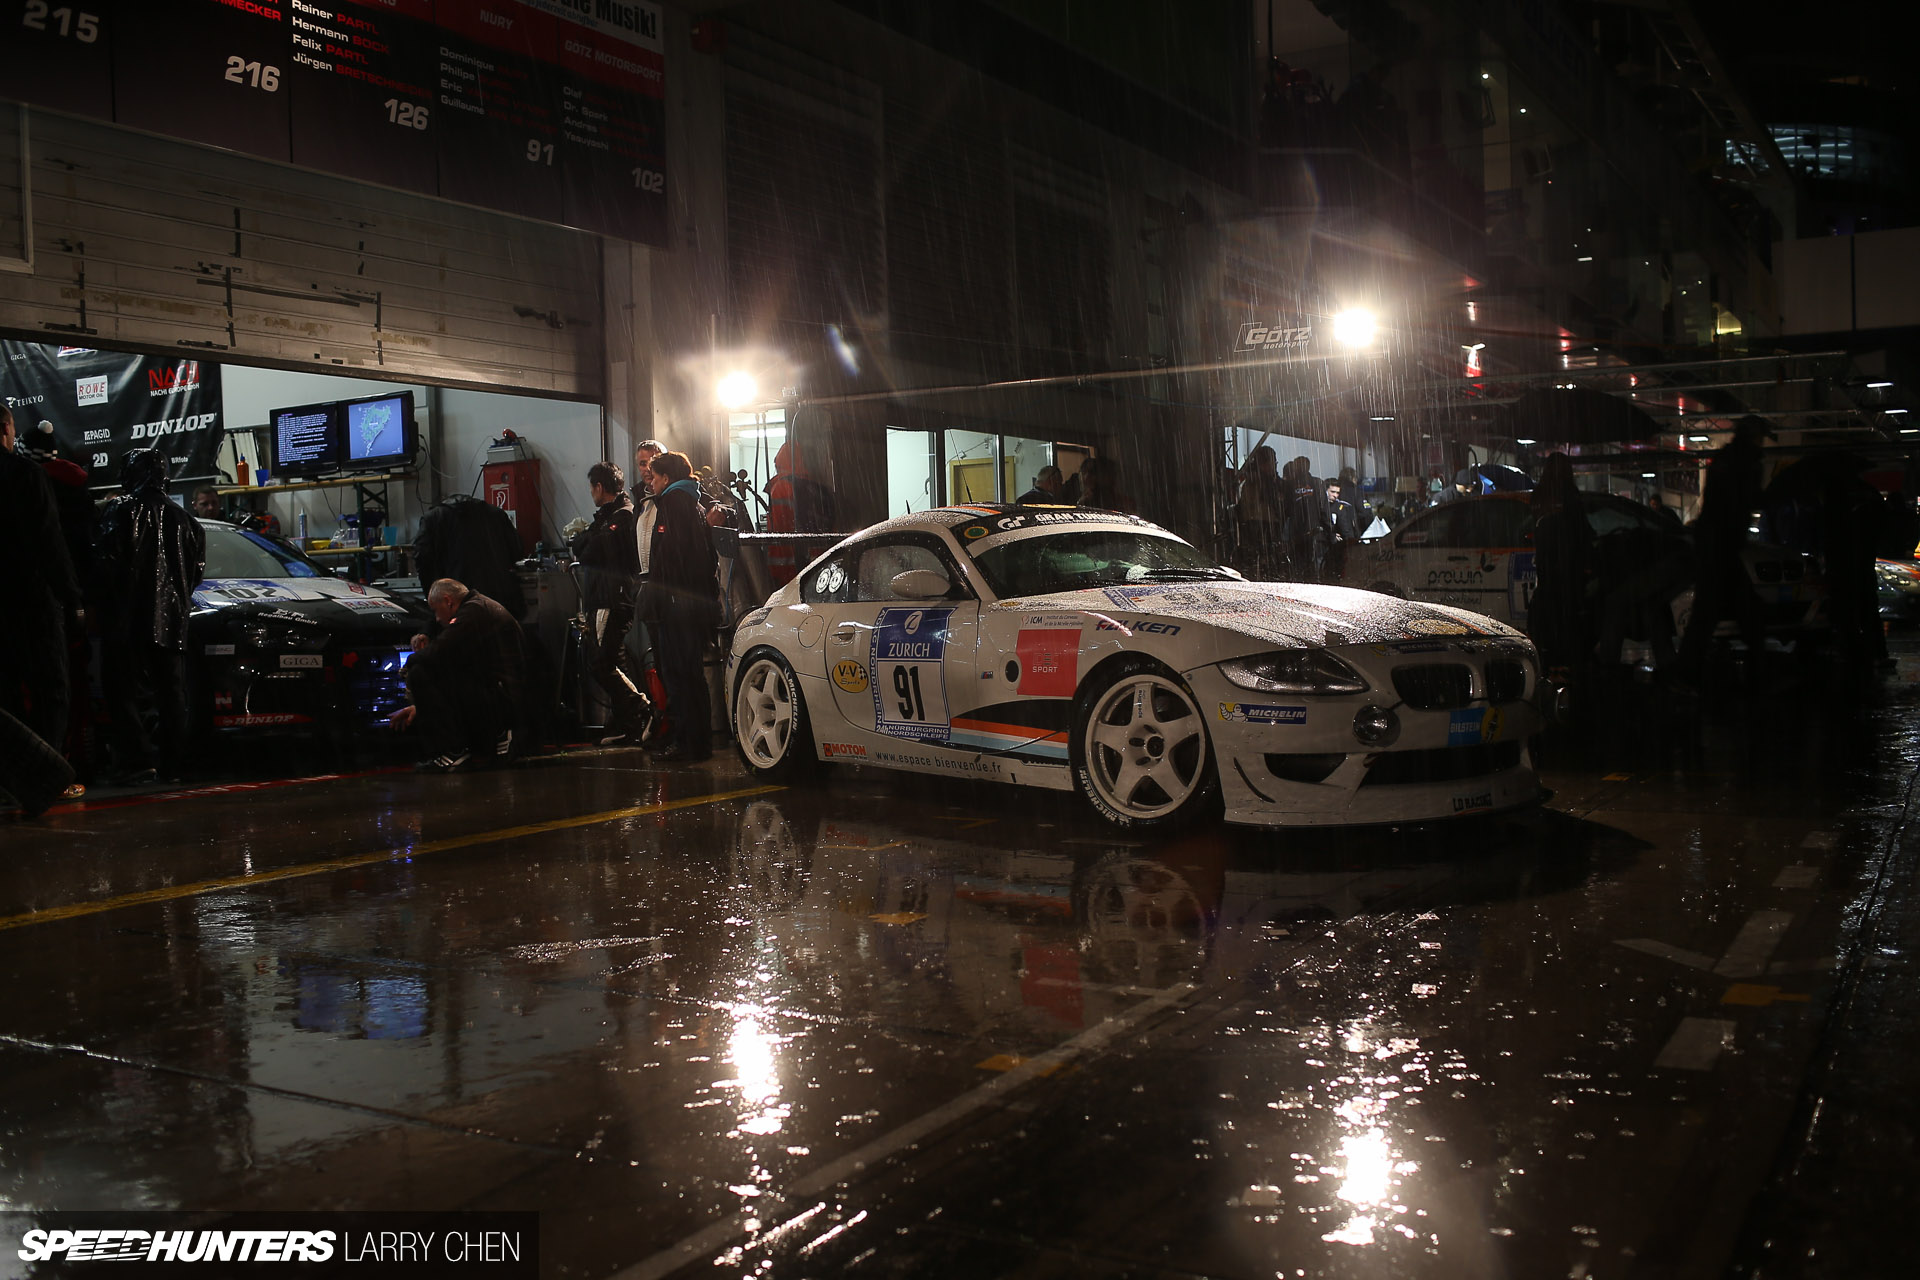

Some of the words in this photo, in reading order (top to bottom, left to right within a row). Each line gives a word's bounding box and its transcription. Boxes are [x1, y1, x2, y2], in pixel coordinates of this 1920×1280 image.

[23, 0, 100, 44] 215
[292, 0, 334, 20] Rainer
[336, 13, 380, 35] PARTL
[480, 9, 514, 31] NURY
[595, 0, 657, 39] Musik!
[292, 16, 350, 42] Hermann
[352, 35, 391, 55] BOCK
[292, 33, 323, 52] Felix
[325, 44, 370, 66] PARTL
[439, 46, 495, 72] Dominique
[224, 55, 281, 93] 216
[292, 52, 333, 72] Jürgen
[594, 49, 663, 83] MOTORSPORT
[440, 79, 463, 93] Eric
[384, 98, 430, 131] 126
[526, 138, 555, 167] 91
[631, 167, 665, 194] 102
[16, 394, 44, 407] TEIKYO
[78, 382, 107, 396] ROWE
[150, 389, 168, 397] NACHI
[90, 428, 111, 440] PAGID
[130, 413, 217, 440] DUNLOP
[92, 452, 109, 468] 2D
[214, 588, 278, 599] 102
[888, 642, 931, 657] ZURICH
[283, 658, 320, 666] GIGA
[870, 647, 882, 724] NORDRHEIN
[893, 664, 926, 721] 91
[787, 677, 800, 731] MICHELIN
[1248, 708, 1306, 718] MICHELIN
[234, 714, 295, 727] DUNLOP
[888, 730, 949, 740] NORDSCHLEIFE
[831, 743, 867, 756] MOTON
